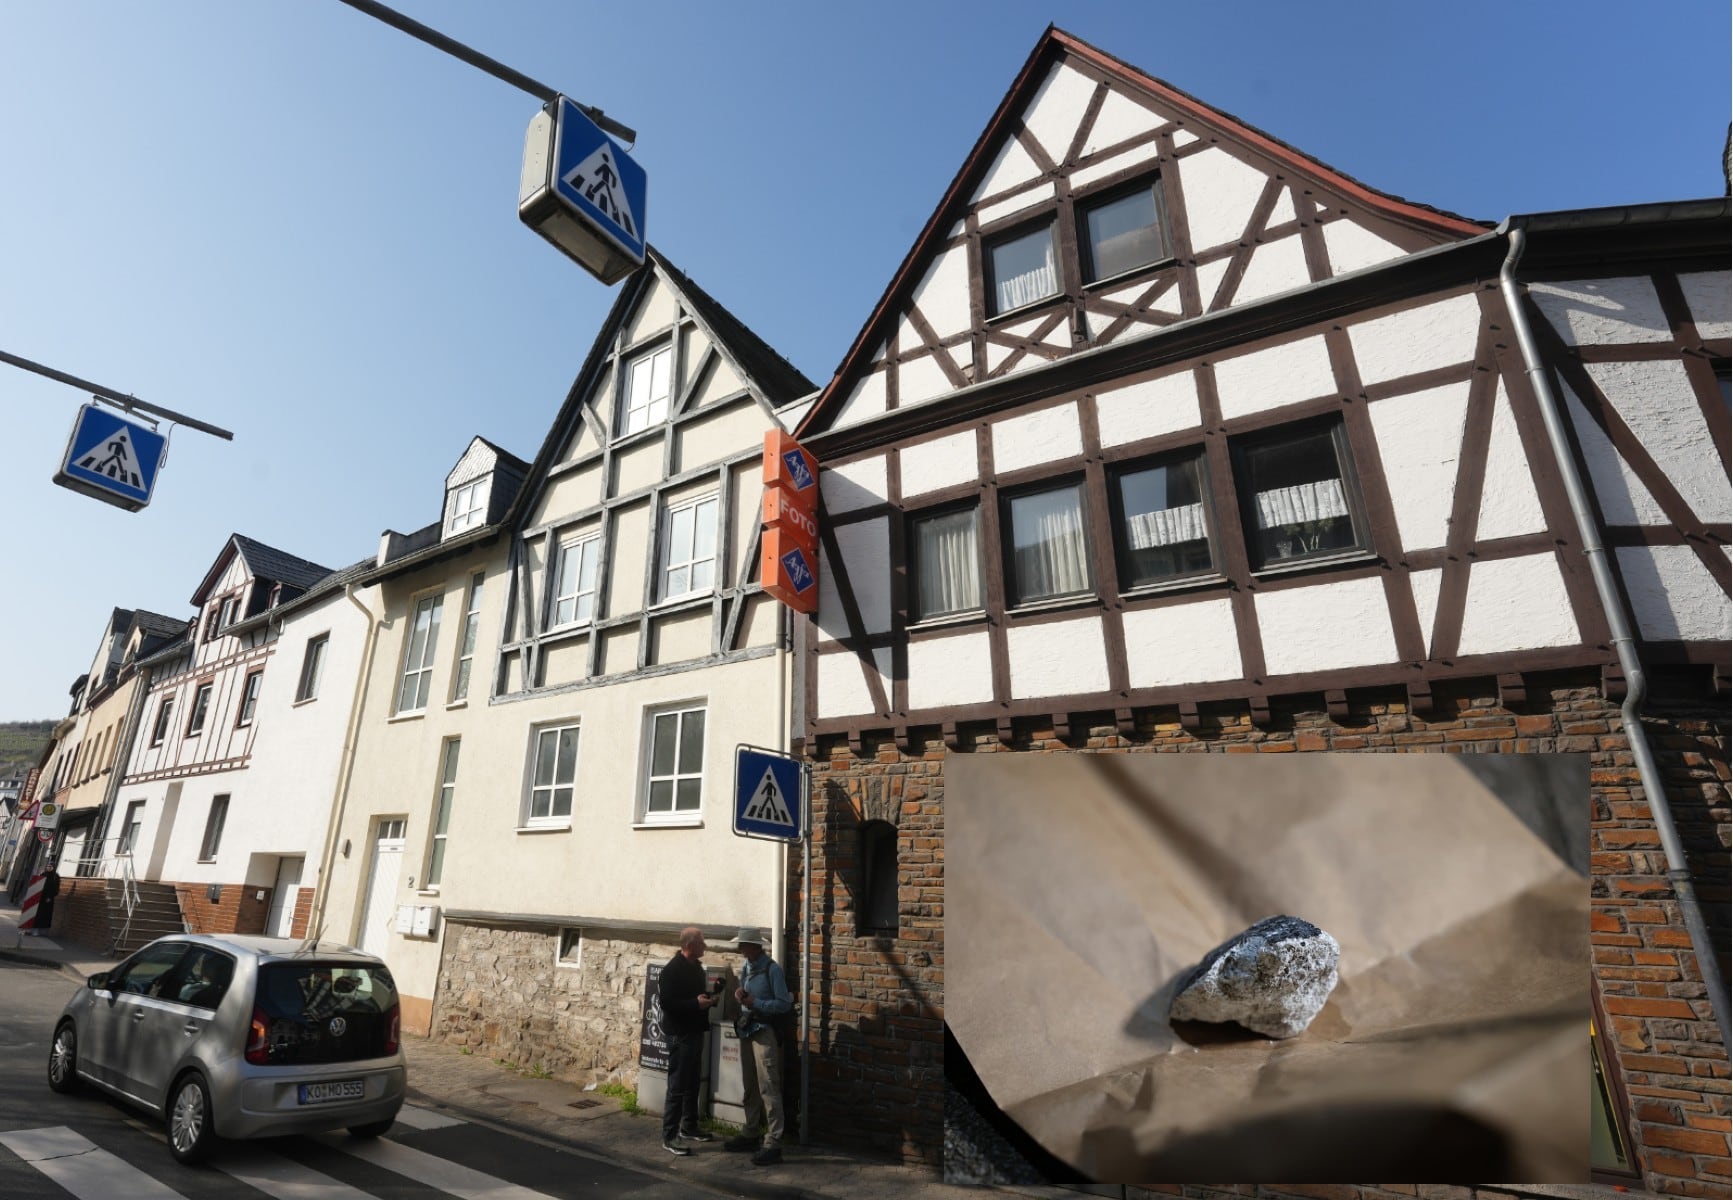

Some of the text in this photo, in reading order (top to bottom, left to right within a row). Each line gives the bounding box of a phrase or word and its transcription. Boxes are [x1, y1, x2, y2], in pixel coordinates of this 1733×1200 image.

[780, 499, 817, 537] FOTO
[408, 876, 415, 888] 2
[343, 1082, 361, 1096] 555
